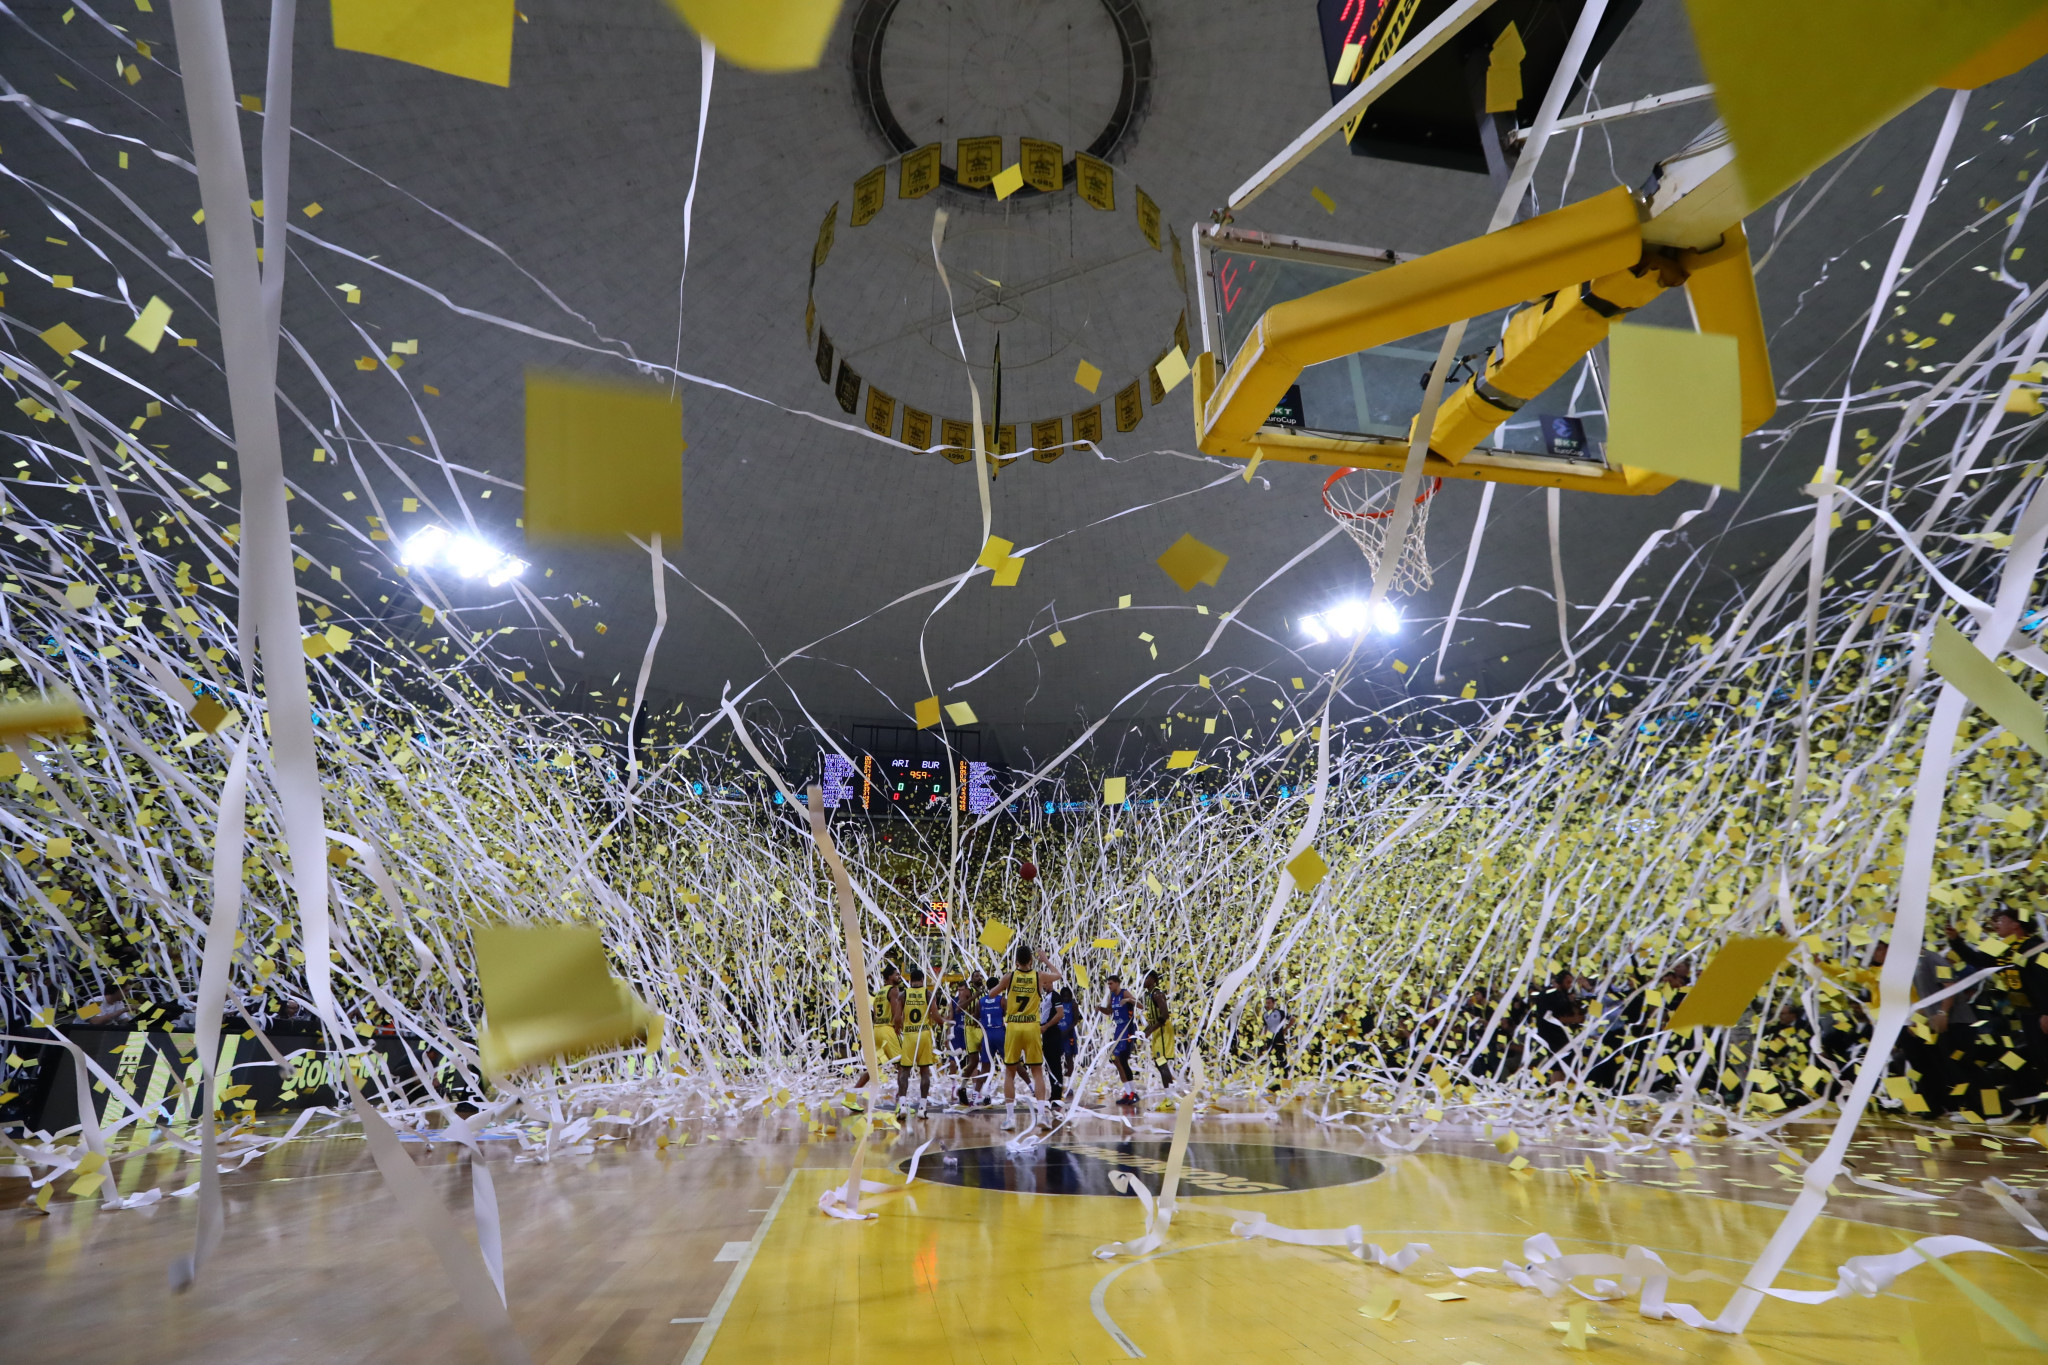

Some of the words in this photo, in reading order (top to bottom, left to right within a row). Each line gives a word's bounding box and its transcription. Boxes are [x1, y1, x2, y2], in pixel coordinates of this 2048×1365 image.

[891, 759, 910, 768] ARI
[922, 760, 940, 769] BUR
[876, 1004, 884, 1017] 3
[1016, 996, 1030, 1013] 7
[909, 1008, 922, 1023] 0
[986, 1013, 993, 1027] 1
